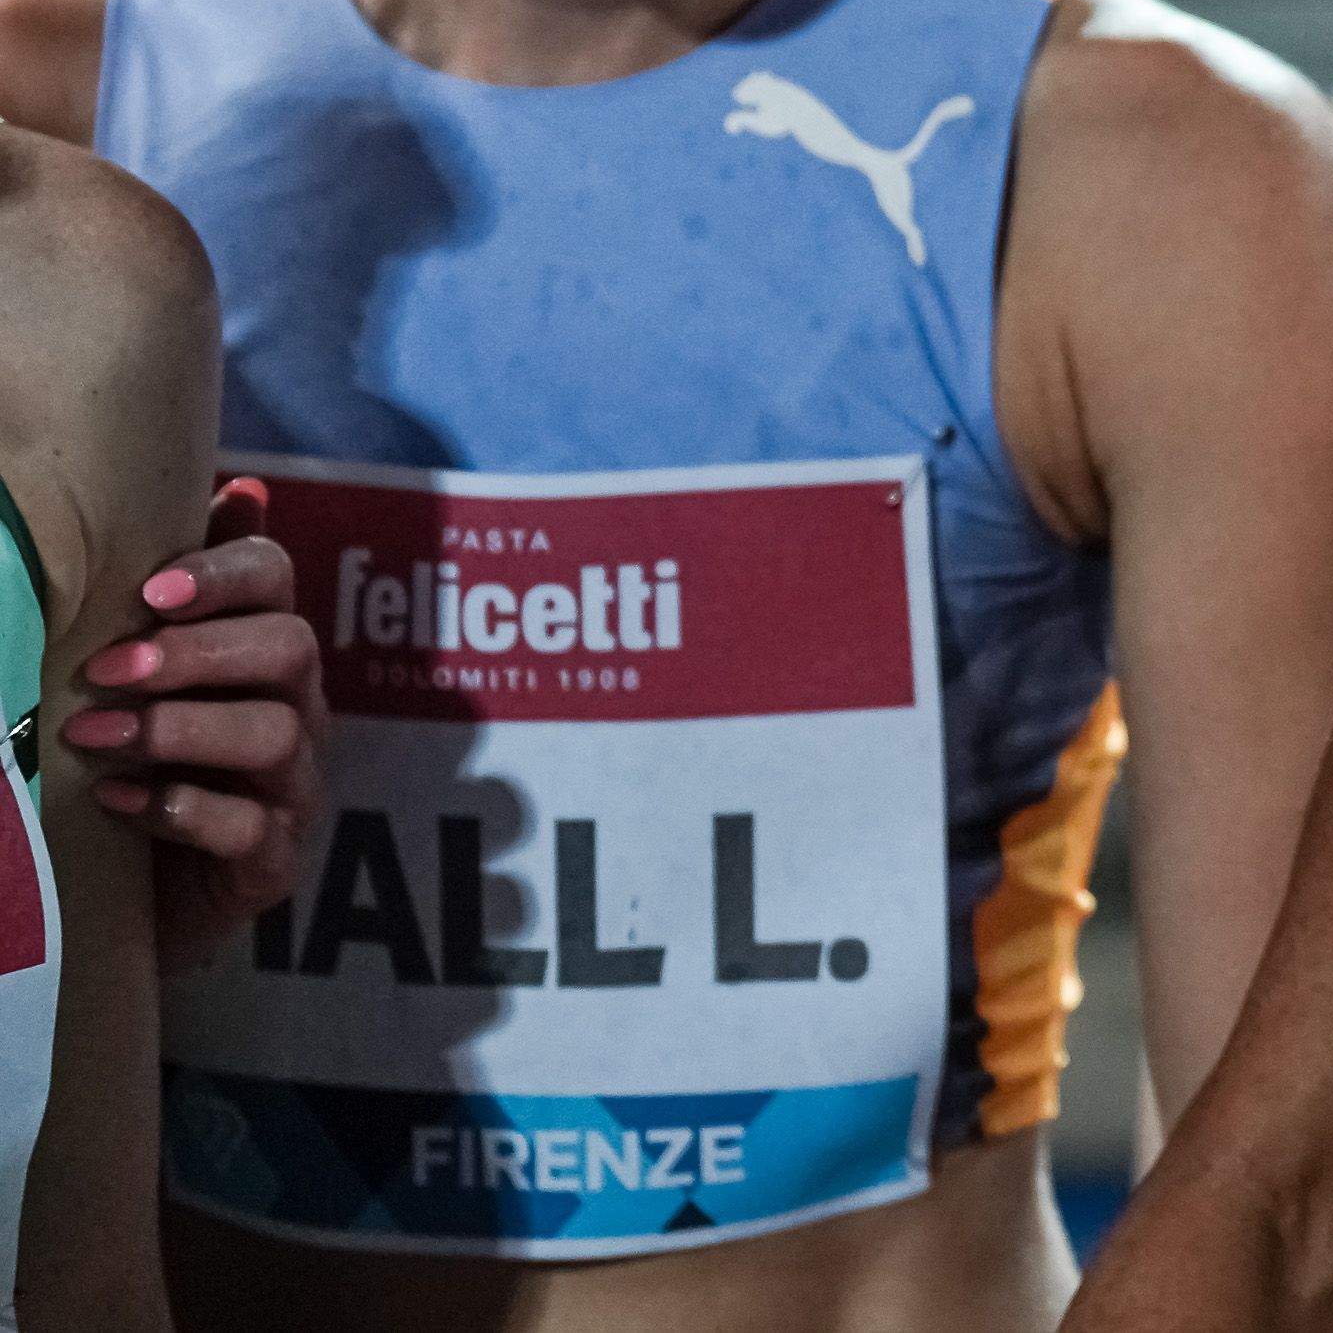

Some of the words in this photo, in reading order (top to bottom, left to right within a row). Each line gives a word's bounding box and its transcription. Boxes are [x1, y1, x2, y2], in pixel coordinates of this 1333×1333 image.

[442, 524, 551, 553] PASTA
[334, 546, 684, 654] felicetti
[366, 665, 538, 691] DOLOMITI
[560, 666, 641, 691] 1908
[253, 807, 666, 990] ALL
[711, 811, 870, 985] L.
[411, 1125, 746, 1193] FIRENZE
